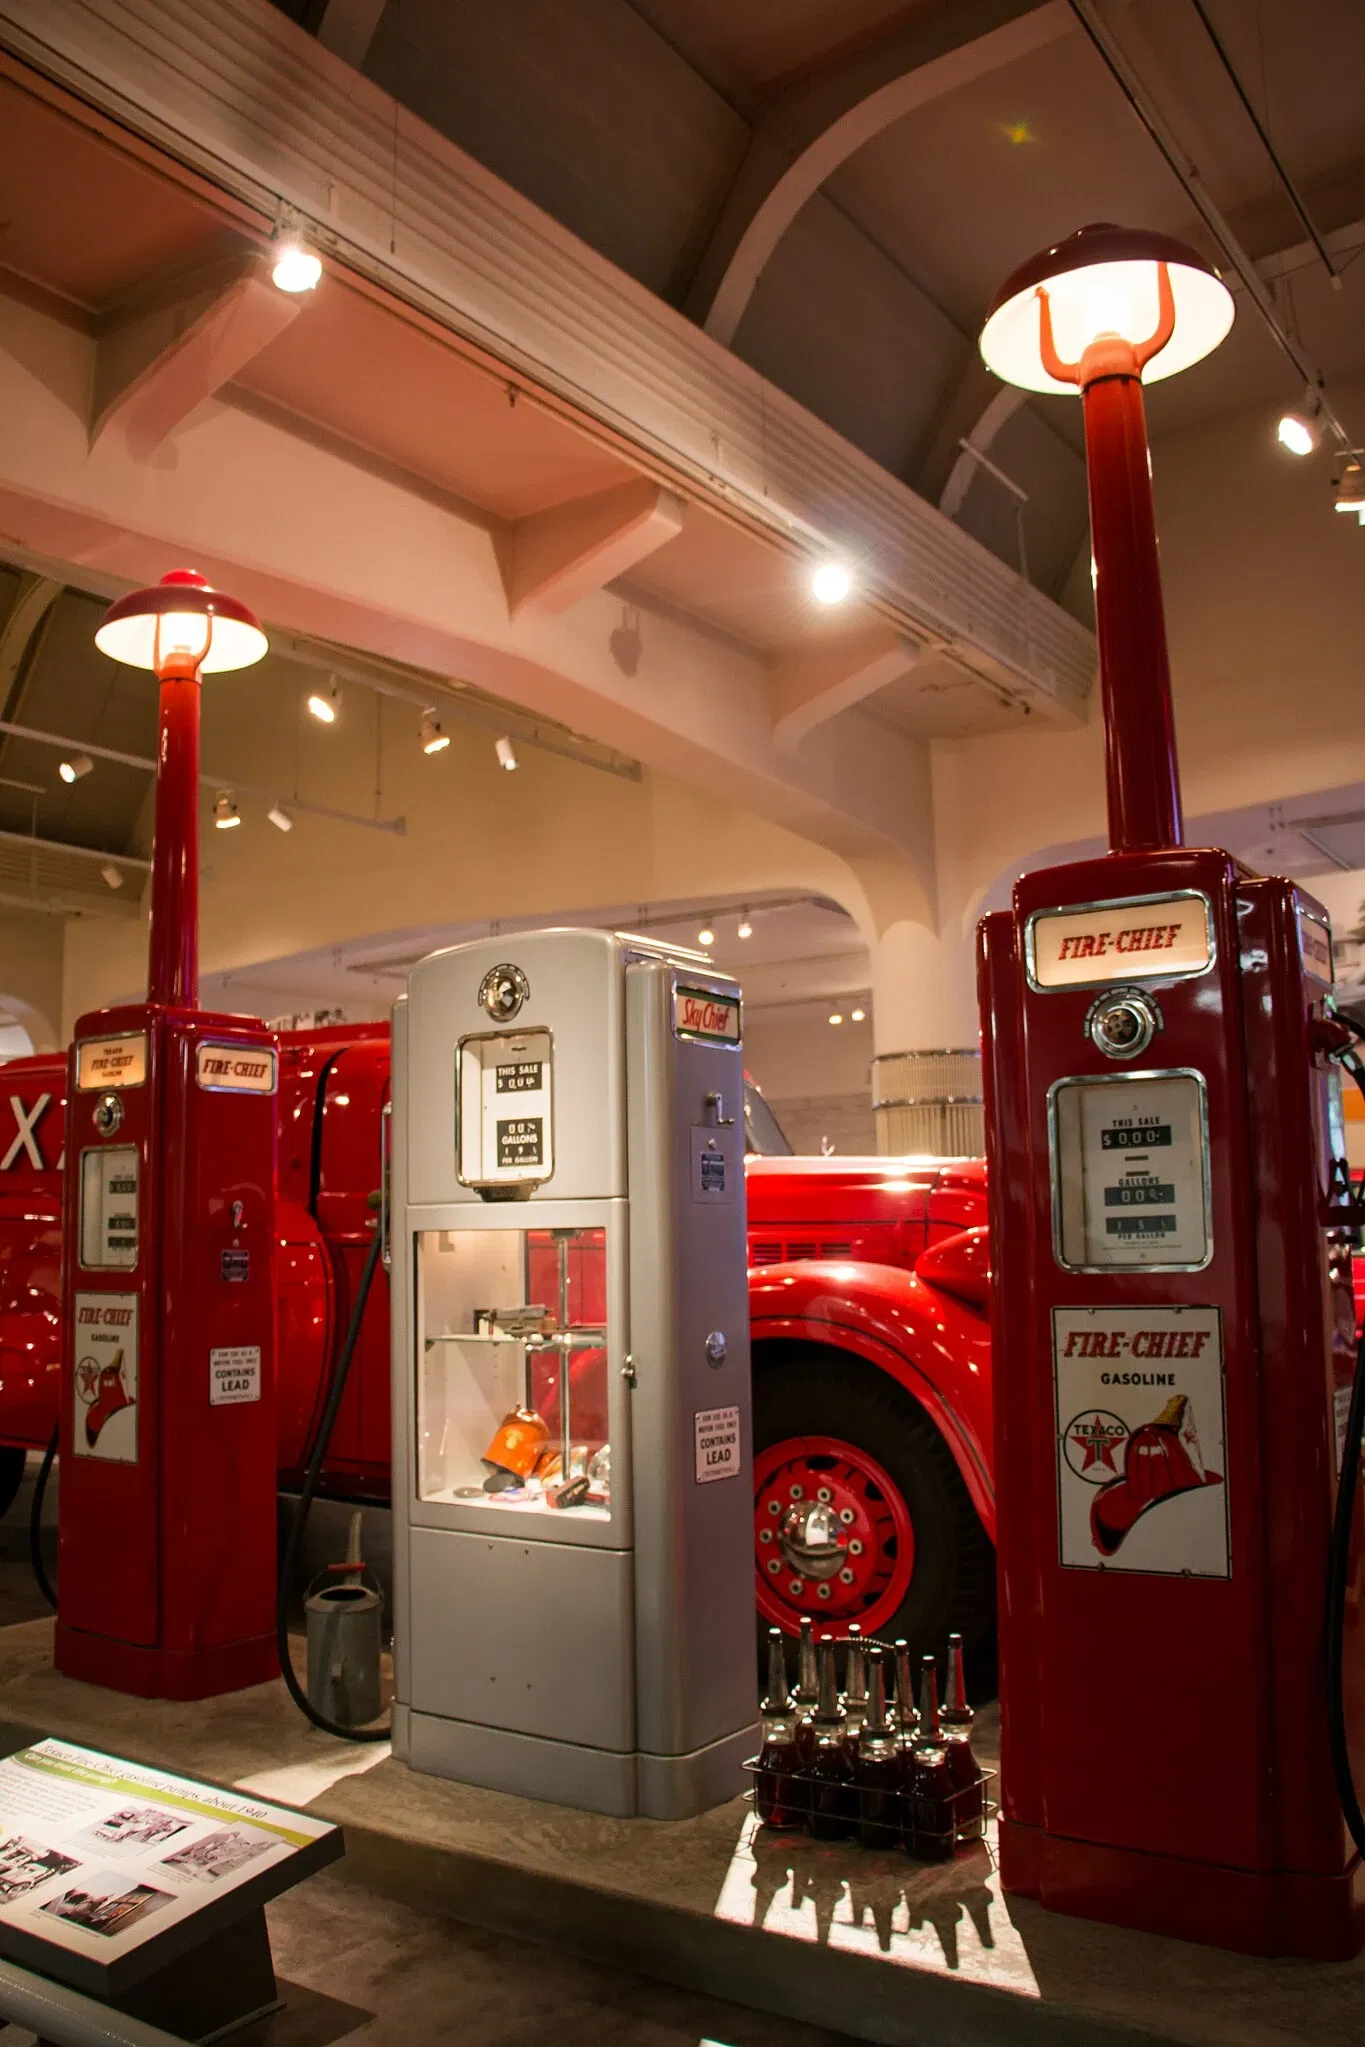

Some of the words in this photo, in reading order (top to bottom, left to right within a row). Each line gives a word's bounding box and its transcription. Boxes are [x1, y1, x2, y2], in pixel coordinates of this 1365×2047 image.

[1058, 923, 1182, 960] FIRE-CHIEF
[683, 999, 703, 1031] Sky
[703, 1003, 730, 1032] Chief
[203, 1059, 268, 1078] FIRE-CHIEF
[498, 1067, 515, 1076] THIS
[519, 1064, 538, 1074] SALE
[1112, 1119, 1133, 1128] THIS
[1138, 1116, 1160, 1126] SALE
[502, 1134, 538, 1145] GALLONS
[1103, 1134, 1111, 1146] $
[1118, 1177, 1160, 1187] GALLONS
[78, 1307, 134, 1327] FIRE-CHIEF
[1063, 1331, 1211, 1359] FIRE-CHIEF
[215, 1368, 256, 1379] CONTAINS
[1101, 1373, 1176, 1386] GASOLINE
[222, 1379, 249, 1392] LEAD
[1073, 1424, 1125, 1436] TEXACO
[700, 1434, 736, 1449] CONTAINS
[706, 1449, 731, 1465] LEAD
[203, 1796, 237, 1812] about
[239, 1805, 268, 1819] 1940
